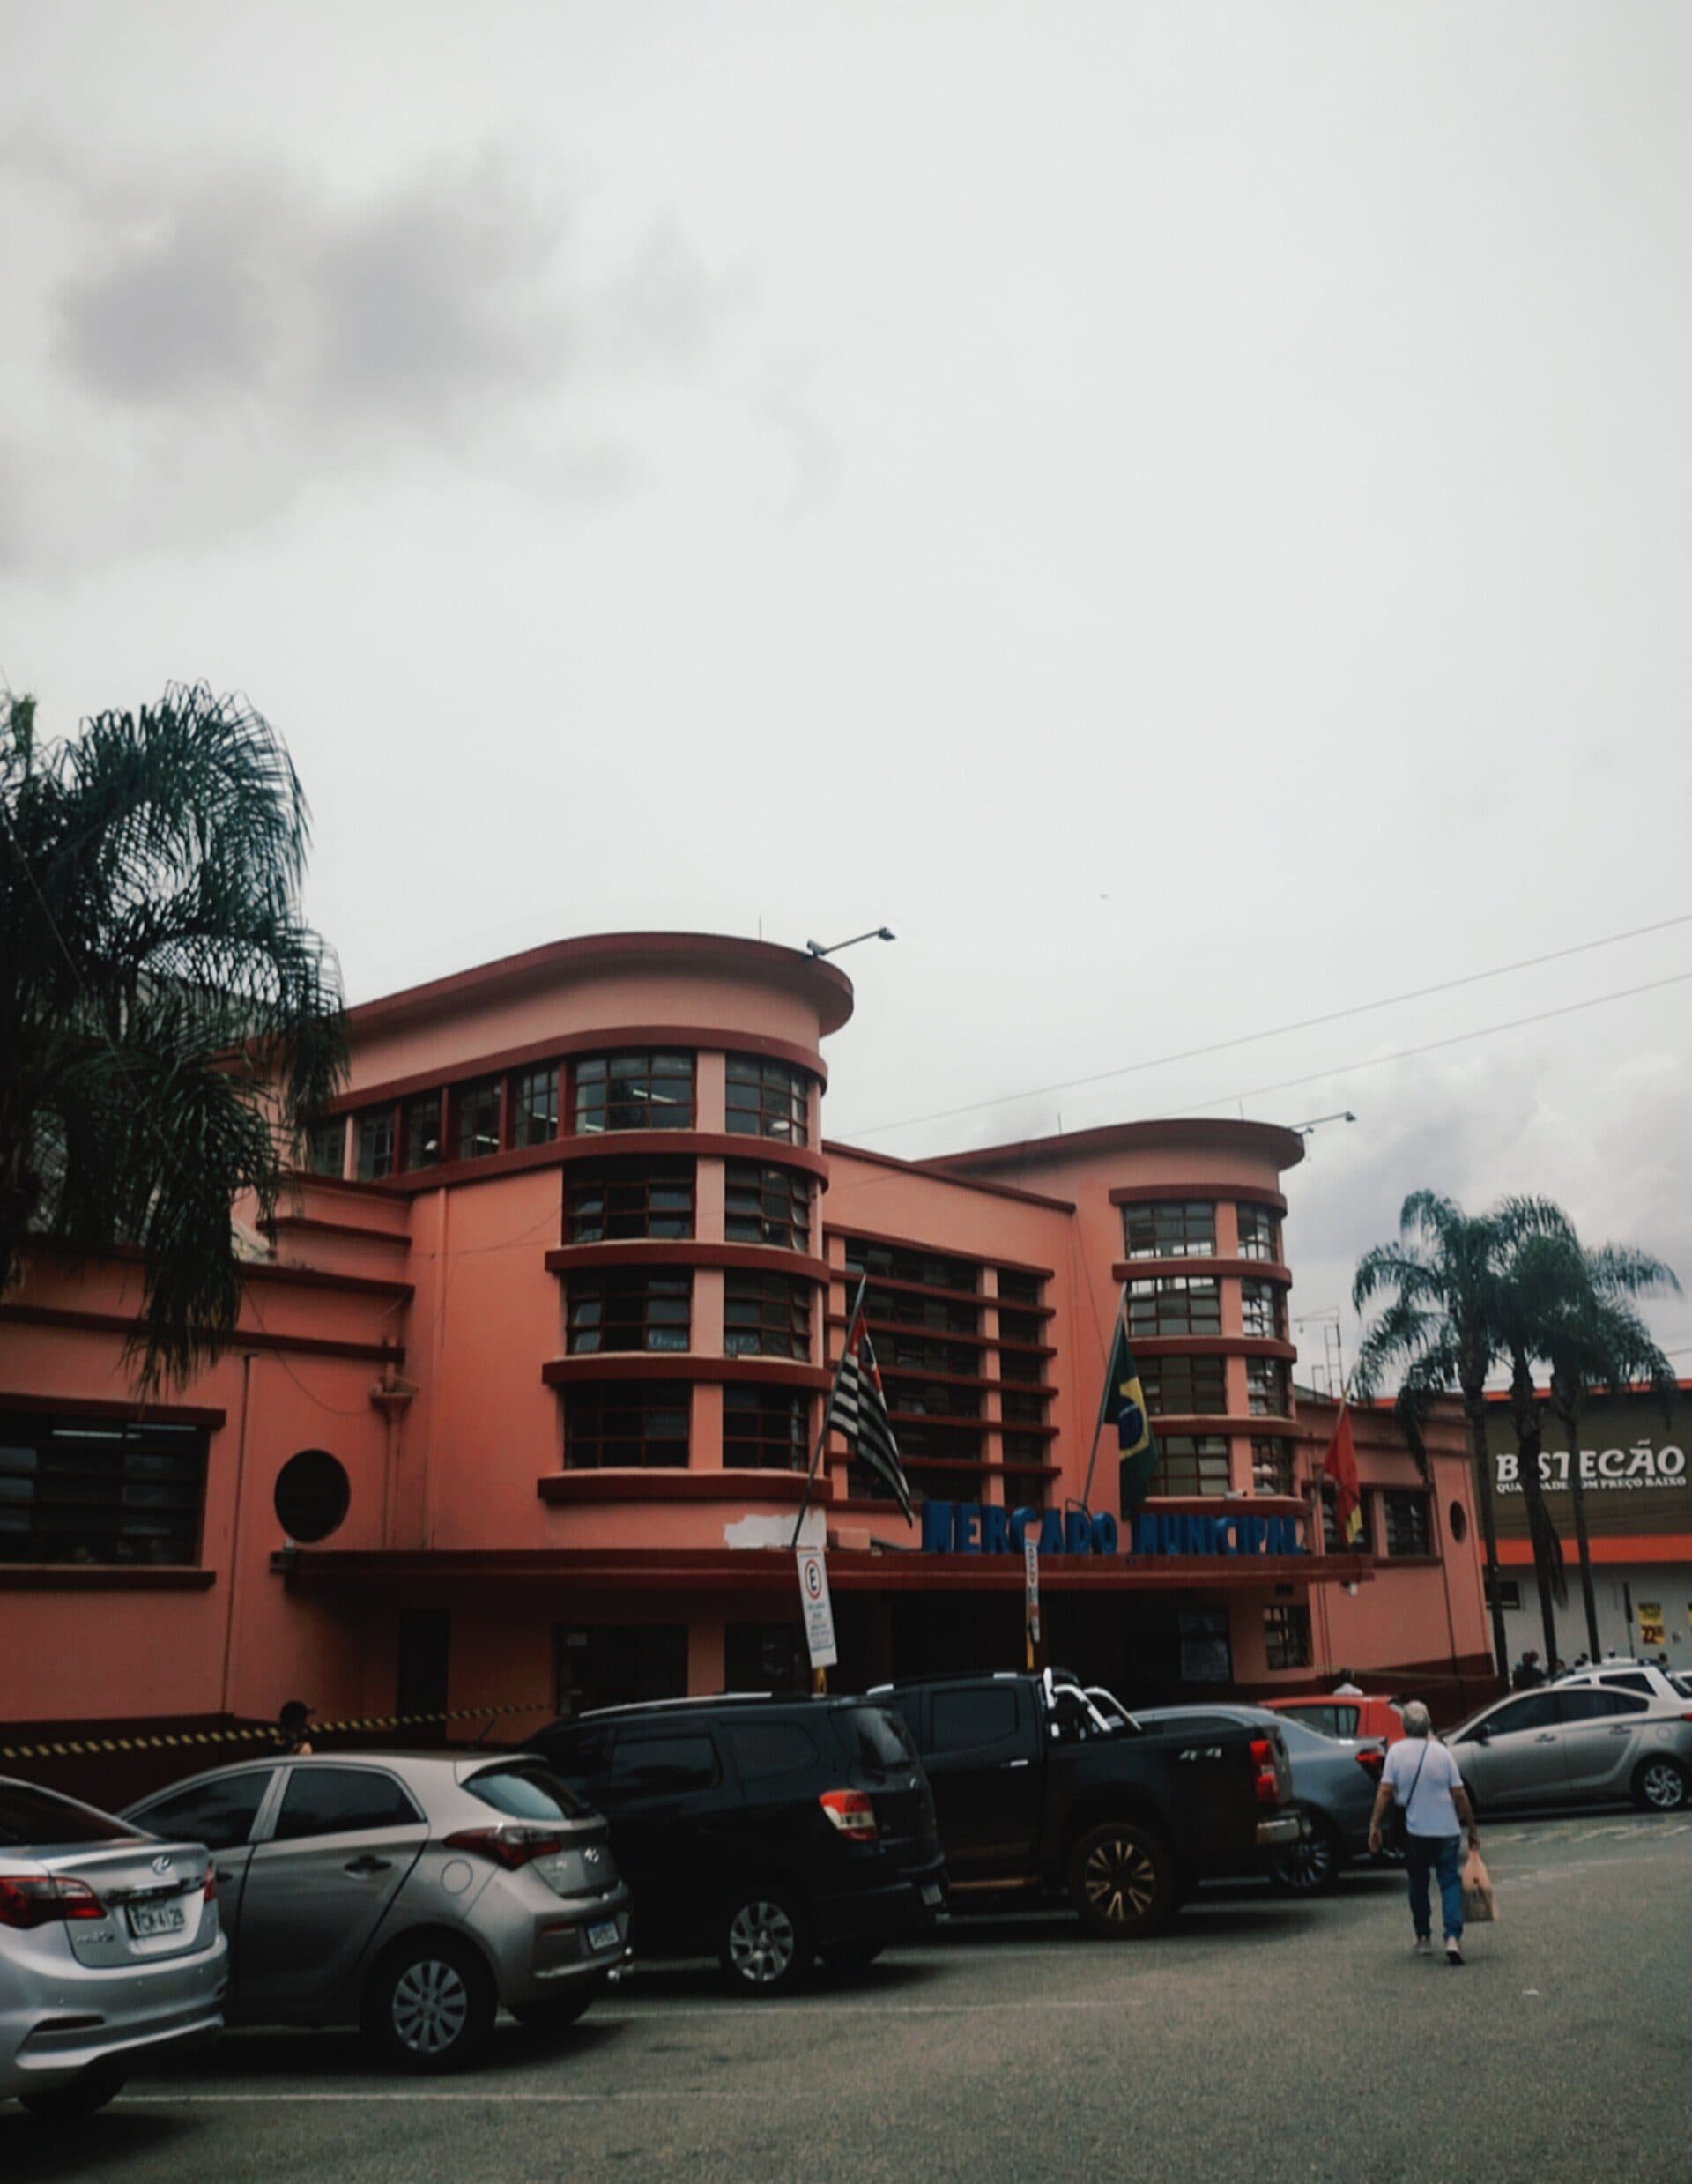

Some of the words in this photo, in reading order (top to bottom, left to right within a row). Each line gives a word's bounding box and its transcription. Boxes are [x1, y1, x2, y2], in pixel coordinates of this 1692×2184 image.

[1495, 1438, 1686, 1482] BSTECÃO
[1600, 1476, 1644, 1491] PREÇO
[1644, 1475, 1687, 1489] BAIXO
[921, 1500, 1117, 1555] MERCADO
[1132, 1512, 1308, 1556] MUNICIPAL
